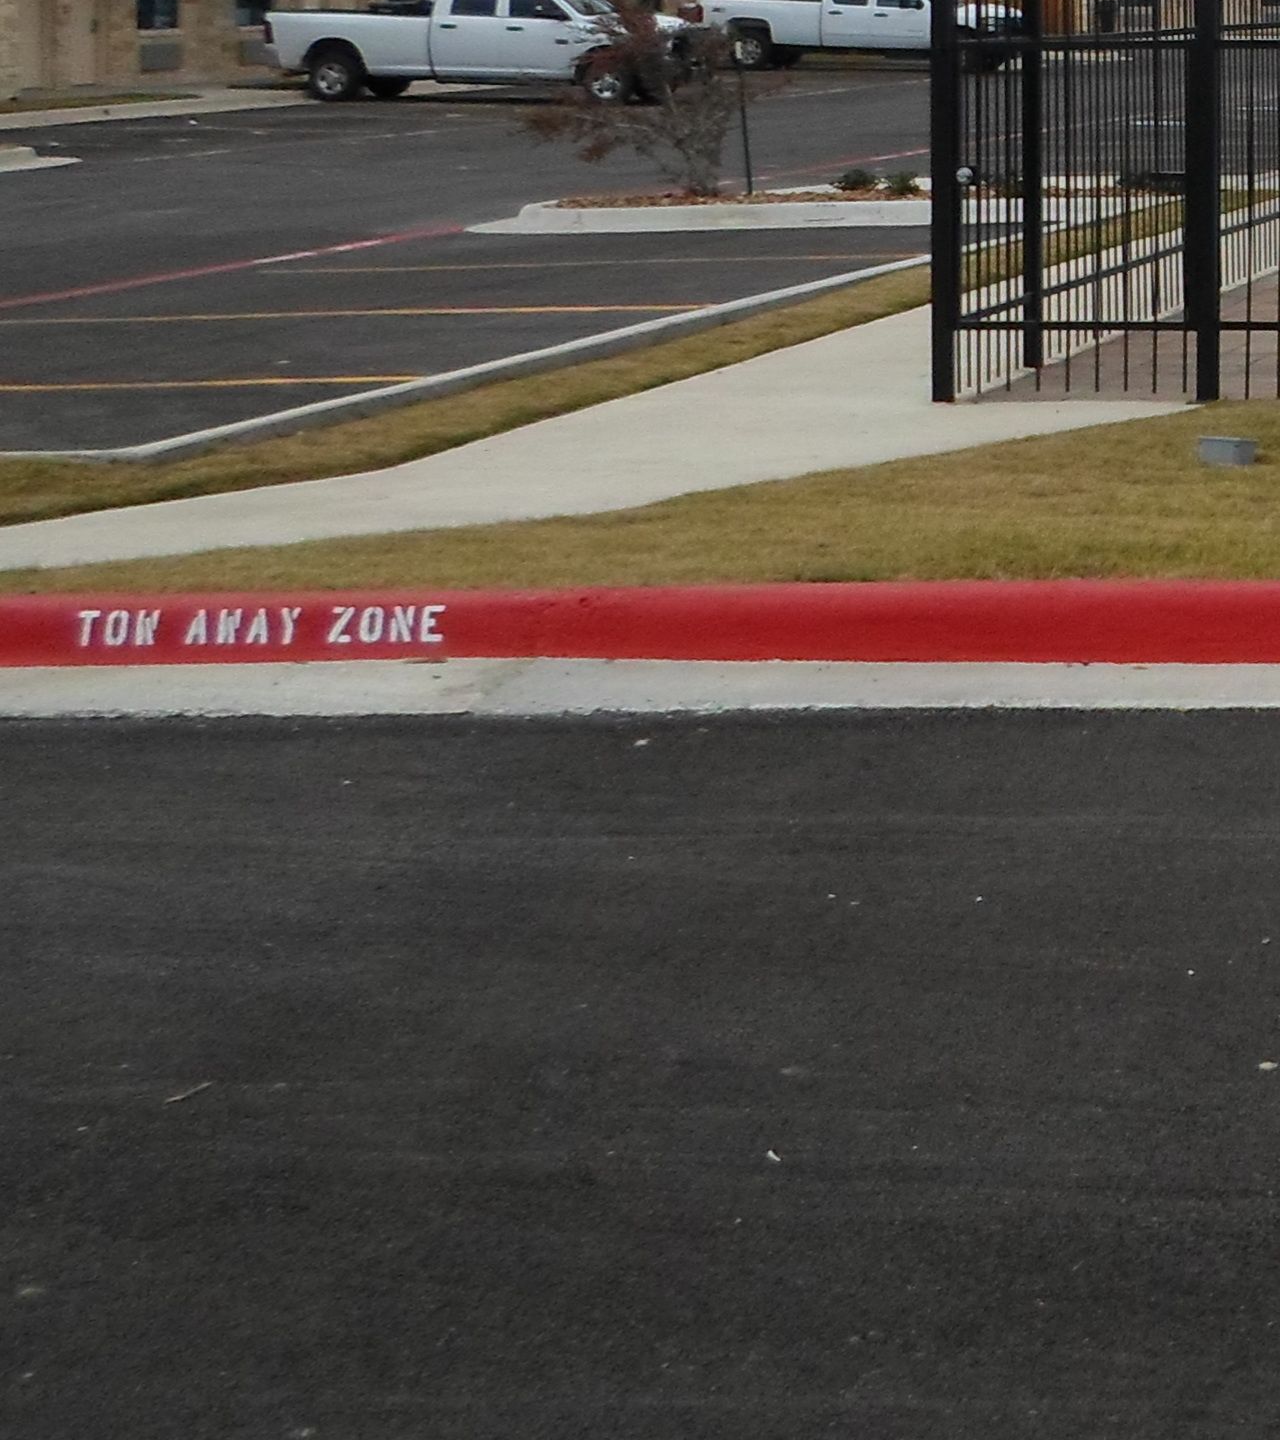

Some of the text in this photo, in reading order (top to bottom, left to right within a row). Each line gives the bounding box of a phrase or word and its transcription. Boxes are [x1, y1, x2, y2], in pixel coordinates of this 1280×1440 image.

[77, 604, 447, 646] TOW AWAY ZONE
